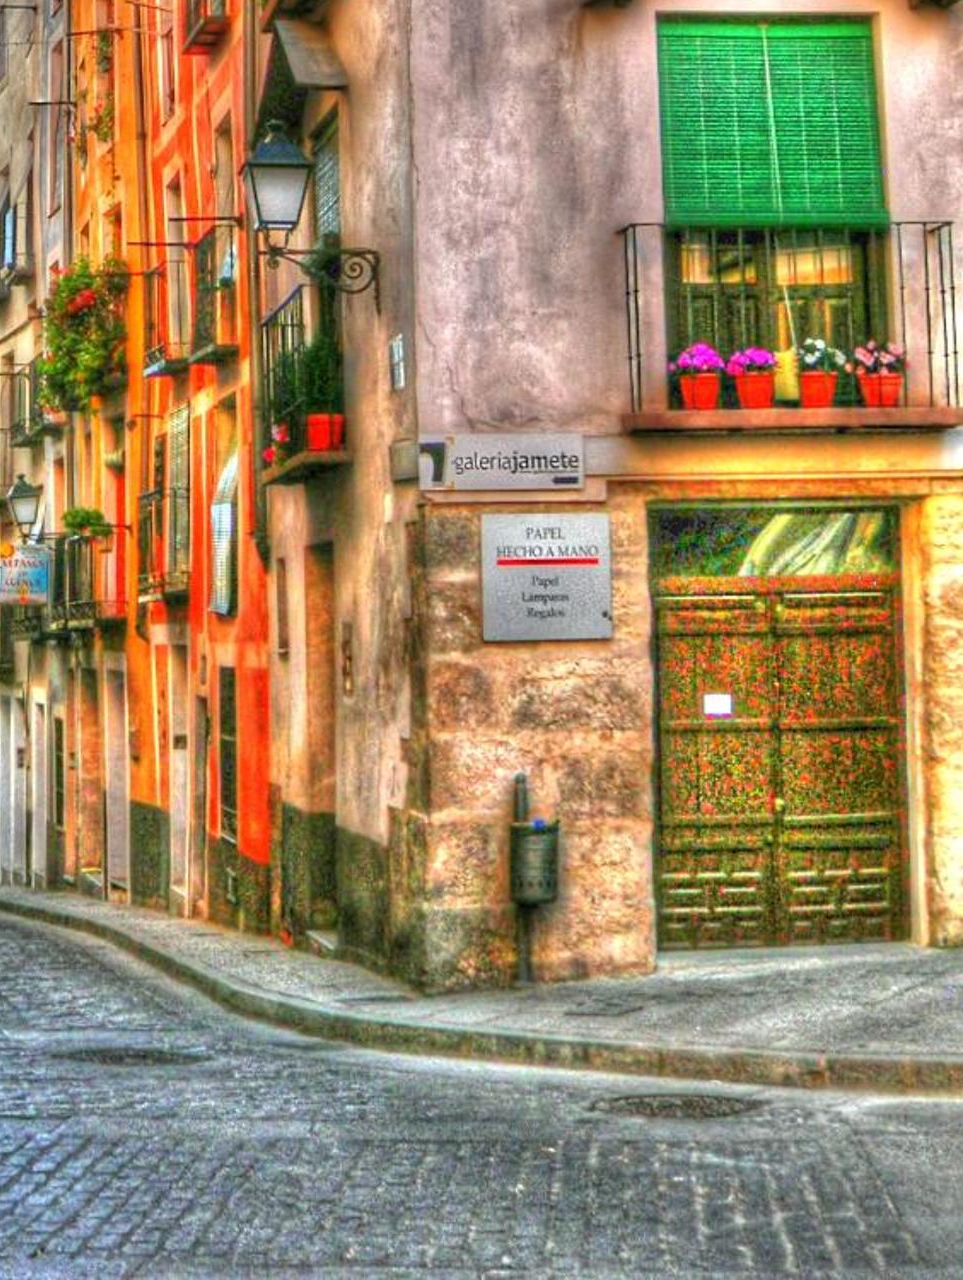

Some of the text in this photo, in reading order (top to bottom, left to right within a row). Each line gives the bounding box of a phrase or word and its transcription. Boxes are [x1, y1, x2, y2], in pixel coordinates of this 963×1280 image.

[454, 451, 580, 475] galeriajamete
[525, 527, 565, 540] PAPEL
[496, 545, 599, 558] HECHO A MANO
[532, 576, 559, 589] Papel
